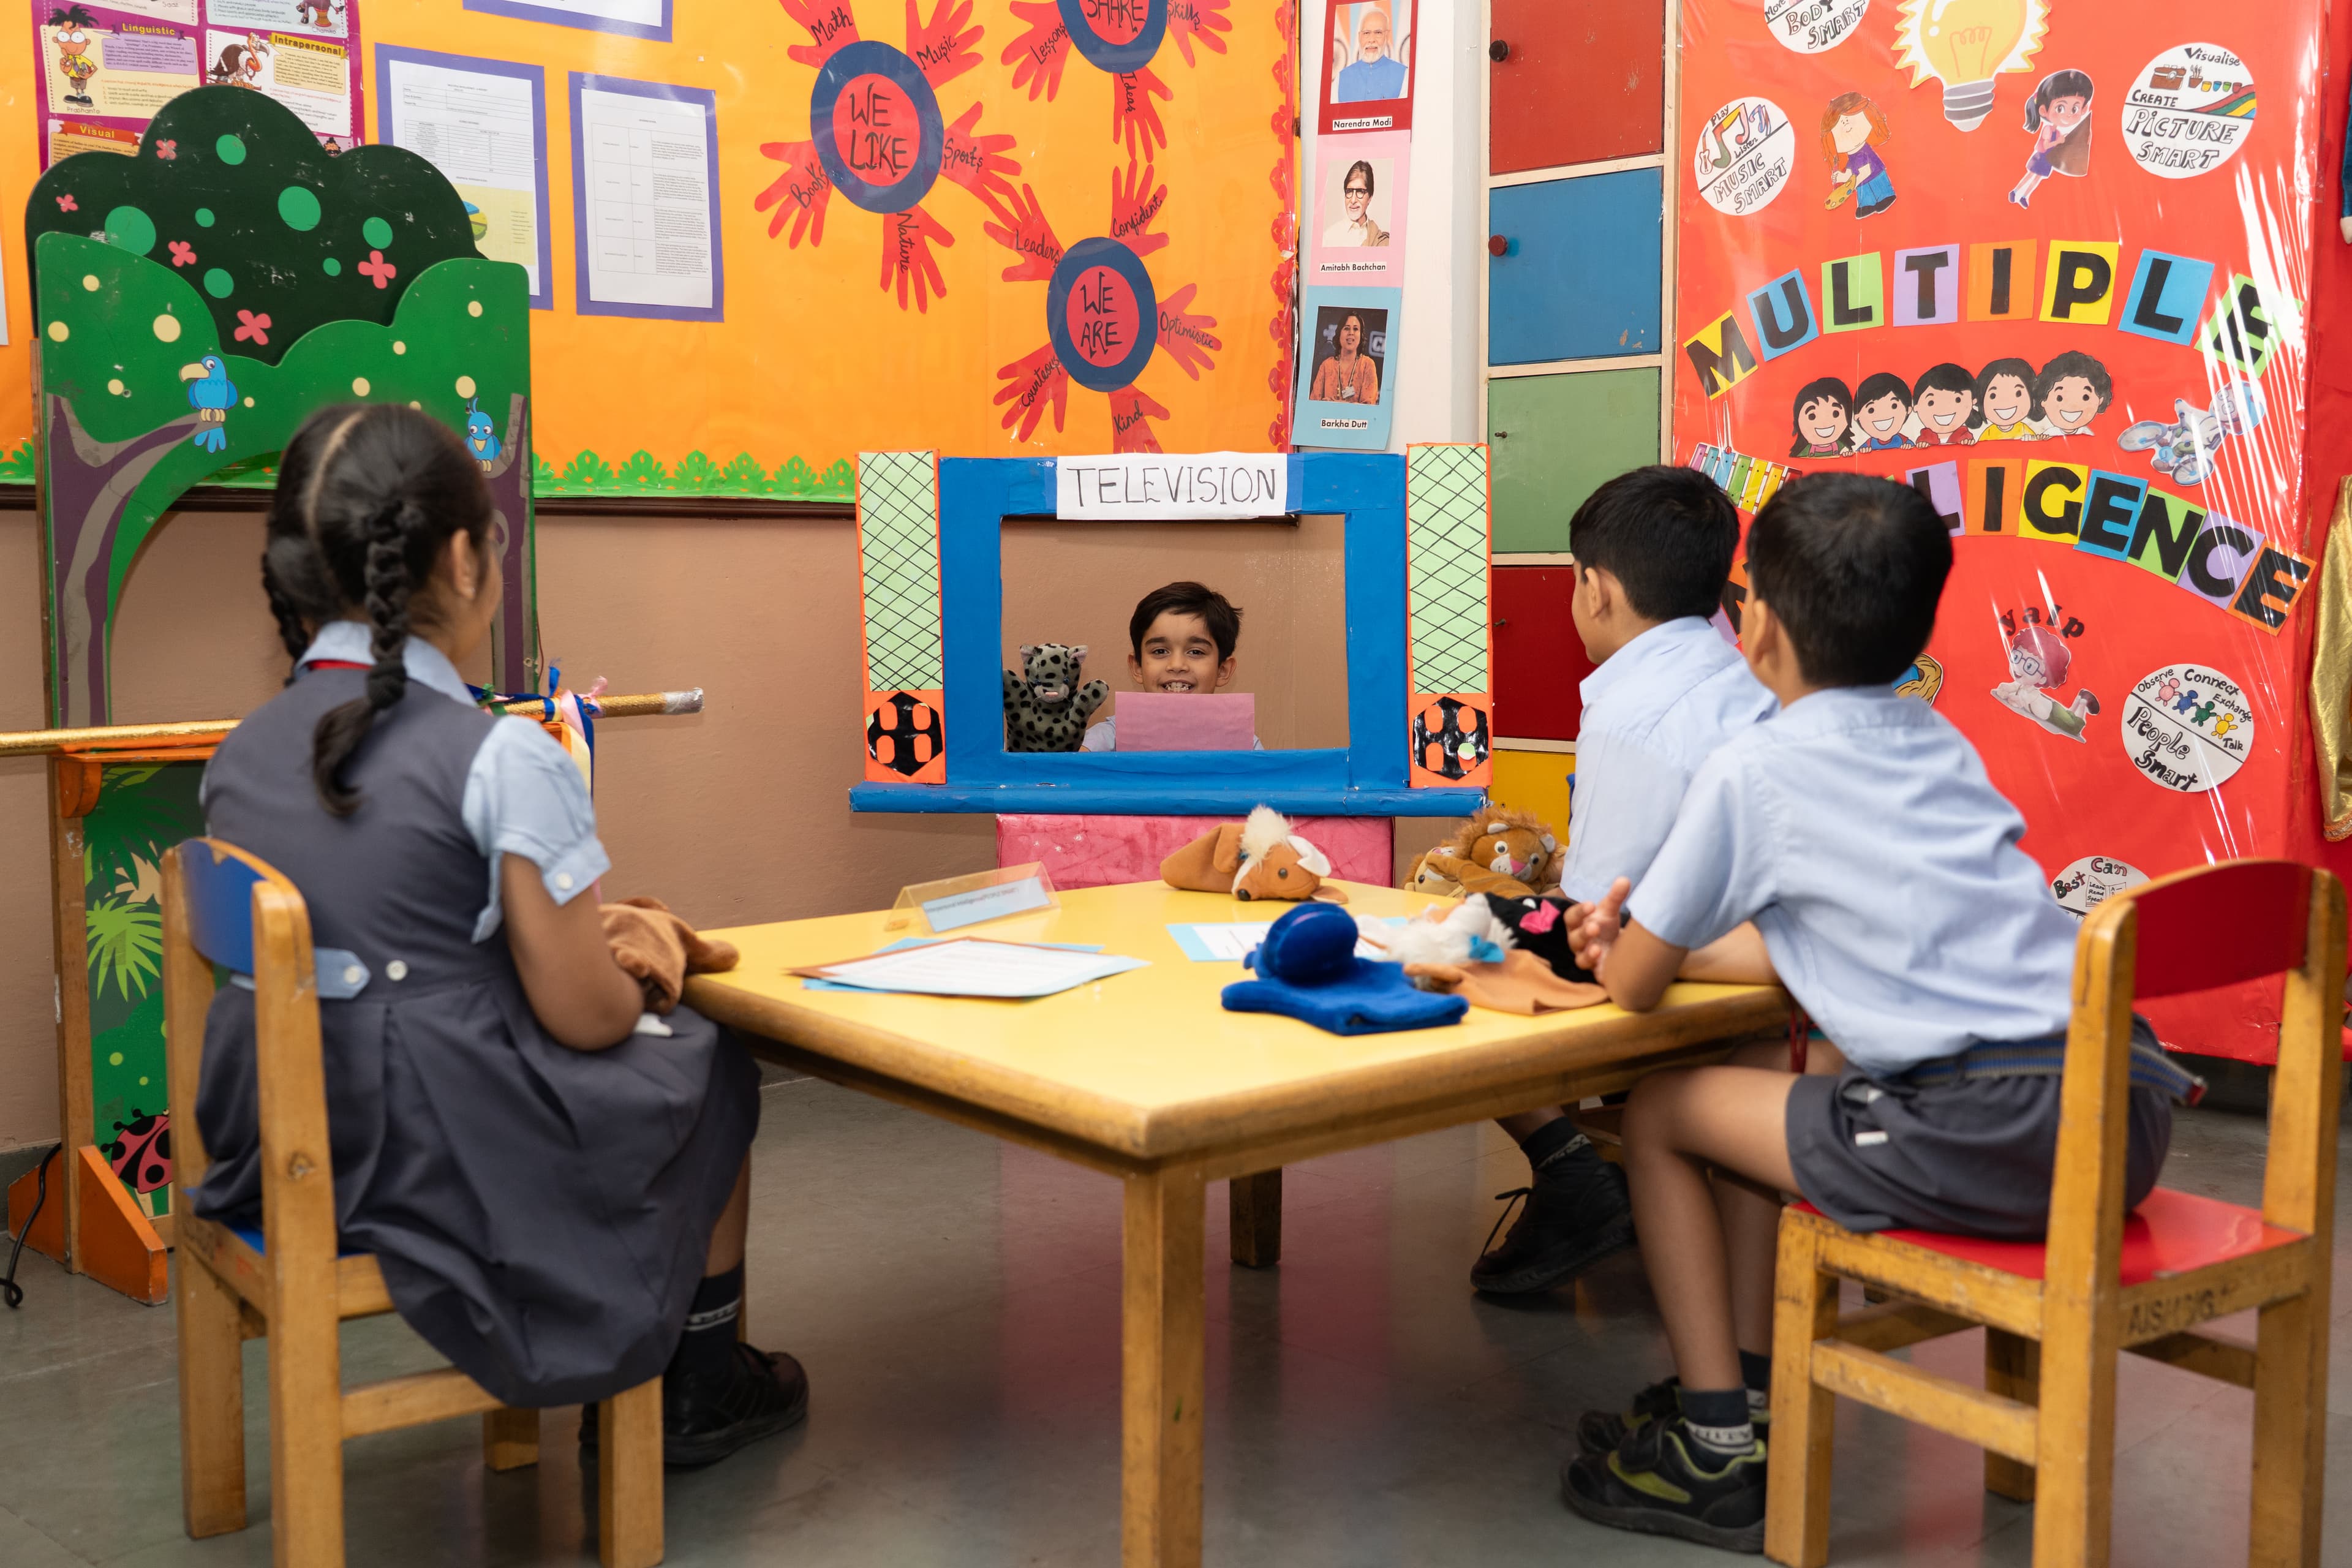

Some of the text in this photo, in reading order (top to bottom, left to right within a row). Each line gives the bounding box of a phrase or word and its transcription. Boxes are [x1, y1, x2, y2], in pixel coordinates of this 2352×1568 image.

[122, 23, 176, 36] Linguistic
[811, 7, 853, 47] Math
[1087, 0, 1147, 33] SHARE
[1167, 1, 1200, 31] Skills
[1785, 0, 1833, 36] BODY
[1807, 0, 1866, 50] SMART
[274, 35, 342, 56] Intrapersonal
[916, 35, 957, 70] Music
[1030, 22, 1067, 65] Lessons
[2184, 47, 2241, 67] Visualise
[850, 83, 891, 127] WE
[1120, 73, 1137, 113] Ideas
[2132, 89, 2179, 107] CREATE
[79, 125, 115, 138] Visual
[1333, 118, 1392, 128] Narendra Modi
[1709, 105, 1730, 127] Play
[850, 129, 908, 178] LIKE
[944, 138, 983, 176] Sports
[1733, 137, 1758, 159] Listen
[2136, 141, 2220, 170] SMART
[791, 162, 829, 209] Books
[1713, 153, 1766, 204] MUSIC
[1734, 157, 1787, 214] SMART
[1112, 194, 1163, 238] Confident
[897, 213, 919, 274] Nature
[1016, 228, 1060, 268] Leaders
[1080, 271, 1118, 315] WE
[1080, 320, 1123, 359] ARE
[1161, 311, 1215, 350] Optimistic
[1686, 247, 2275, 398] MULTIPLE
[1021, 356, 1061, 407] Courteous
[1114, 400, 1143, 435] Kind
[1066, 466, 1276, 507] TELEVISION
[2137, 668, 2174, 693] Observe
[2184, 668, 2240, 696] Connect
[2212, 693, 2252, 723] Exchange
[2127, 706, 2190, 760] People
[2222, 737, 2244, 751] Talk
[2134, 750, 2198, 791] Smart
[2052, 871, 2086, 899] Best
[2090, 858, 2128, 876] Can
